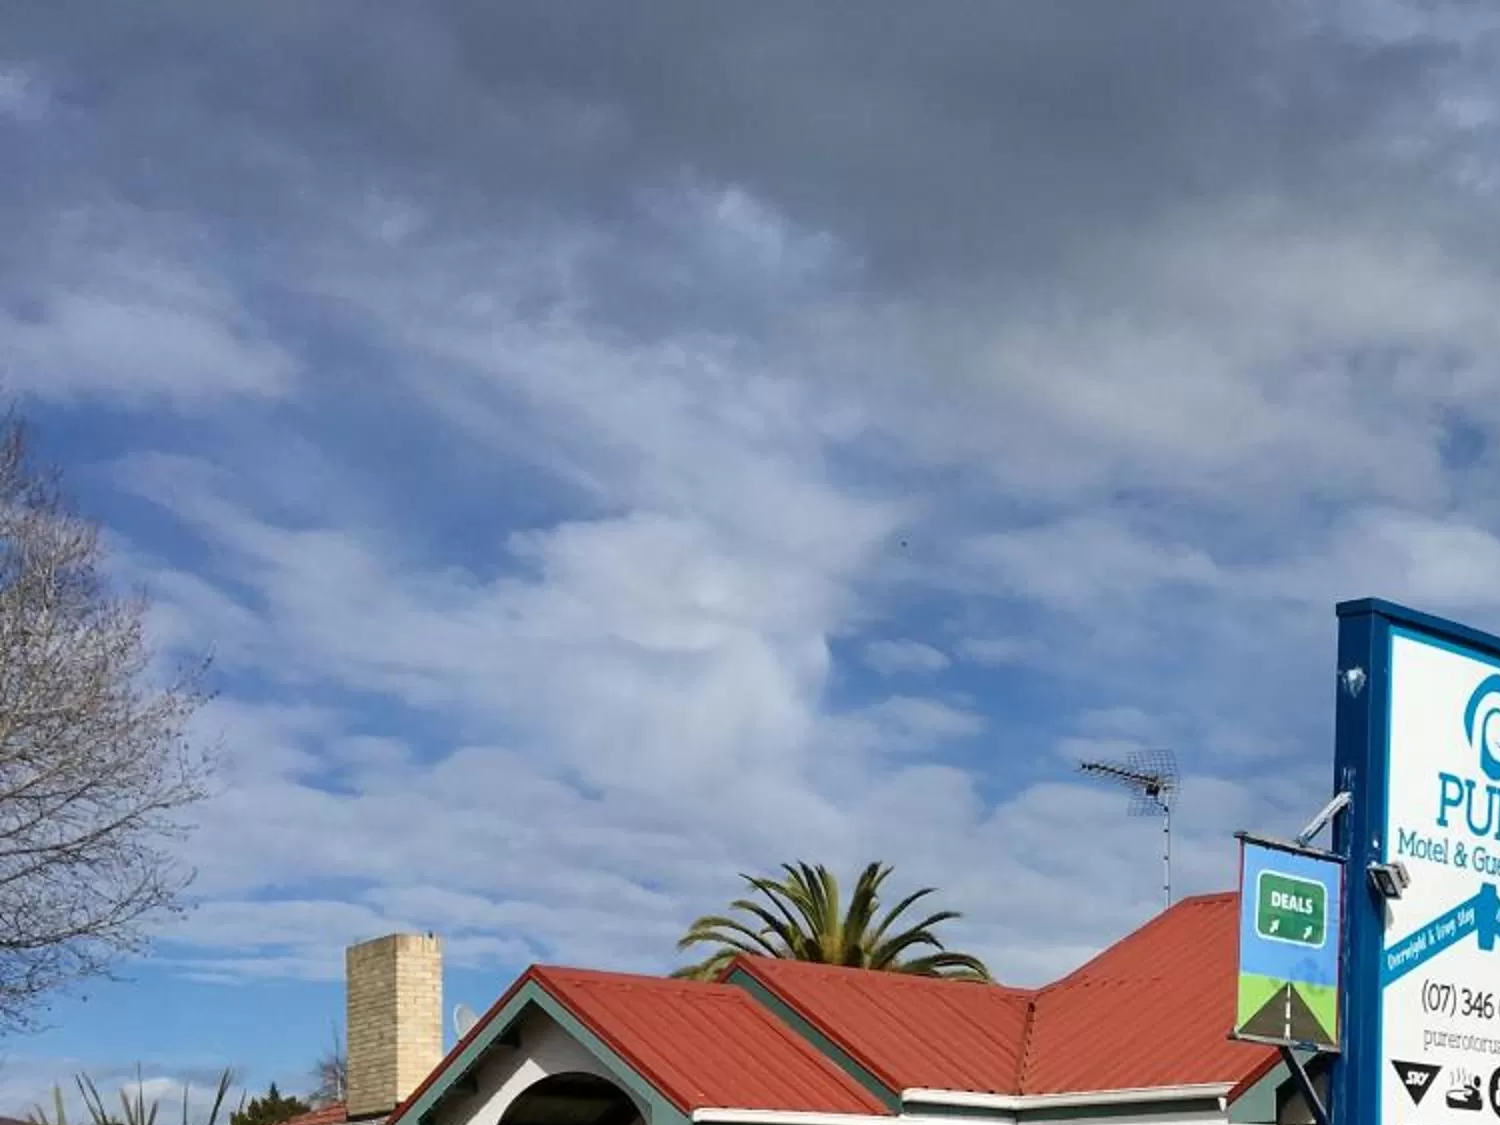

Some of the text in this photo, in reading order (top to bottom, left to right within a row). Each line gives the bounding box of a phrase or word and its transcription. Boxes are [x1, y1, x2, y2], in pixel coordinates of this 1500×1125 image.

[1398, 827, 1449, 865] Motel
[1454, 841, 1468, 869] &
[1271, 890, 1314, 915] DEALS
[1421, 978, 1457, 1018] (07)
[1461, 988, 1495, 1020] 346
[1404, 1070, 1431, 1087] SKY
